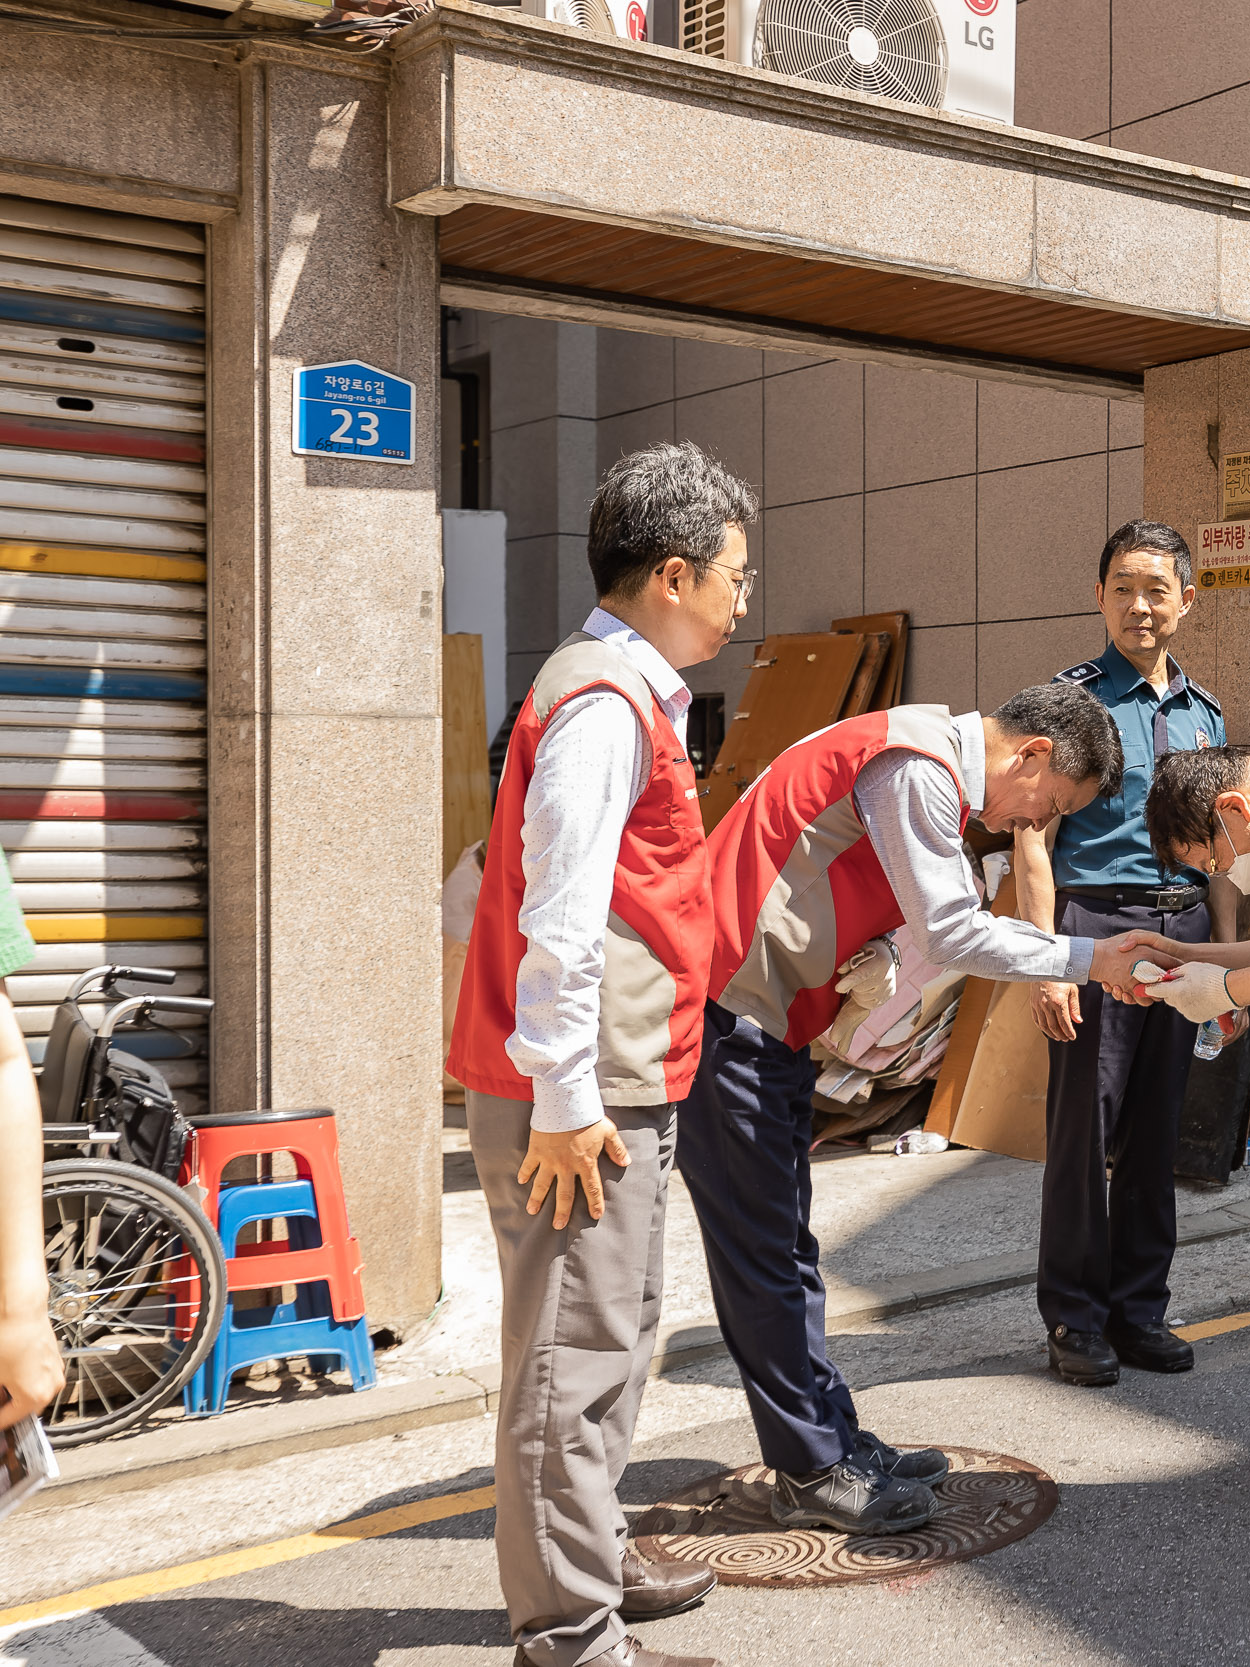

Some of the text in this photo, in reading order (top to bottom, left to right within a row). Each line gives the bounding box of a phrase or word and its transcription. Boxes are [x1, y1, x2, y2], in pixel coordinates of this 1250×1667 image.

[965, 20, 994, 50] LG
[324, 375, 385, 395] 자양로6길
[324, 390, 387, 405] Jayang-ro 6-gil
[329, 408, 380, 447] 23
[1202, 524, 1246, 553] 외부차량
[1218, 567, 1243, 585] 렌트카
